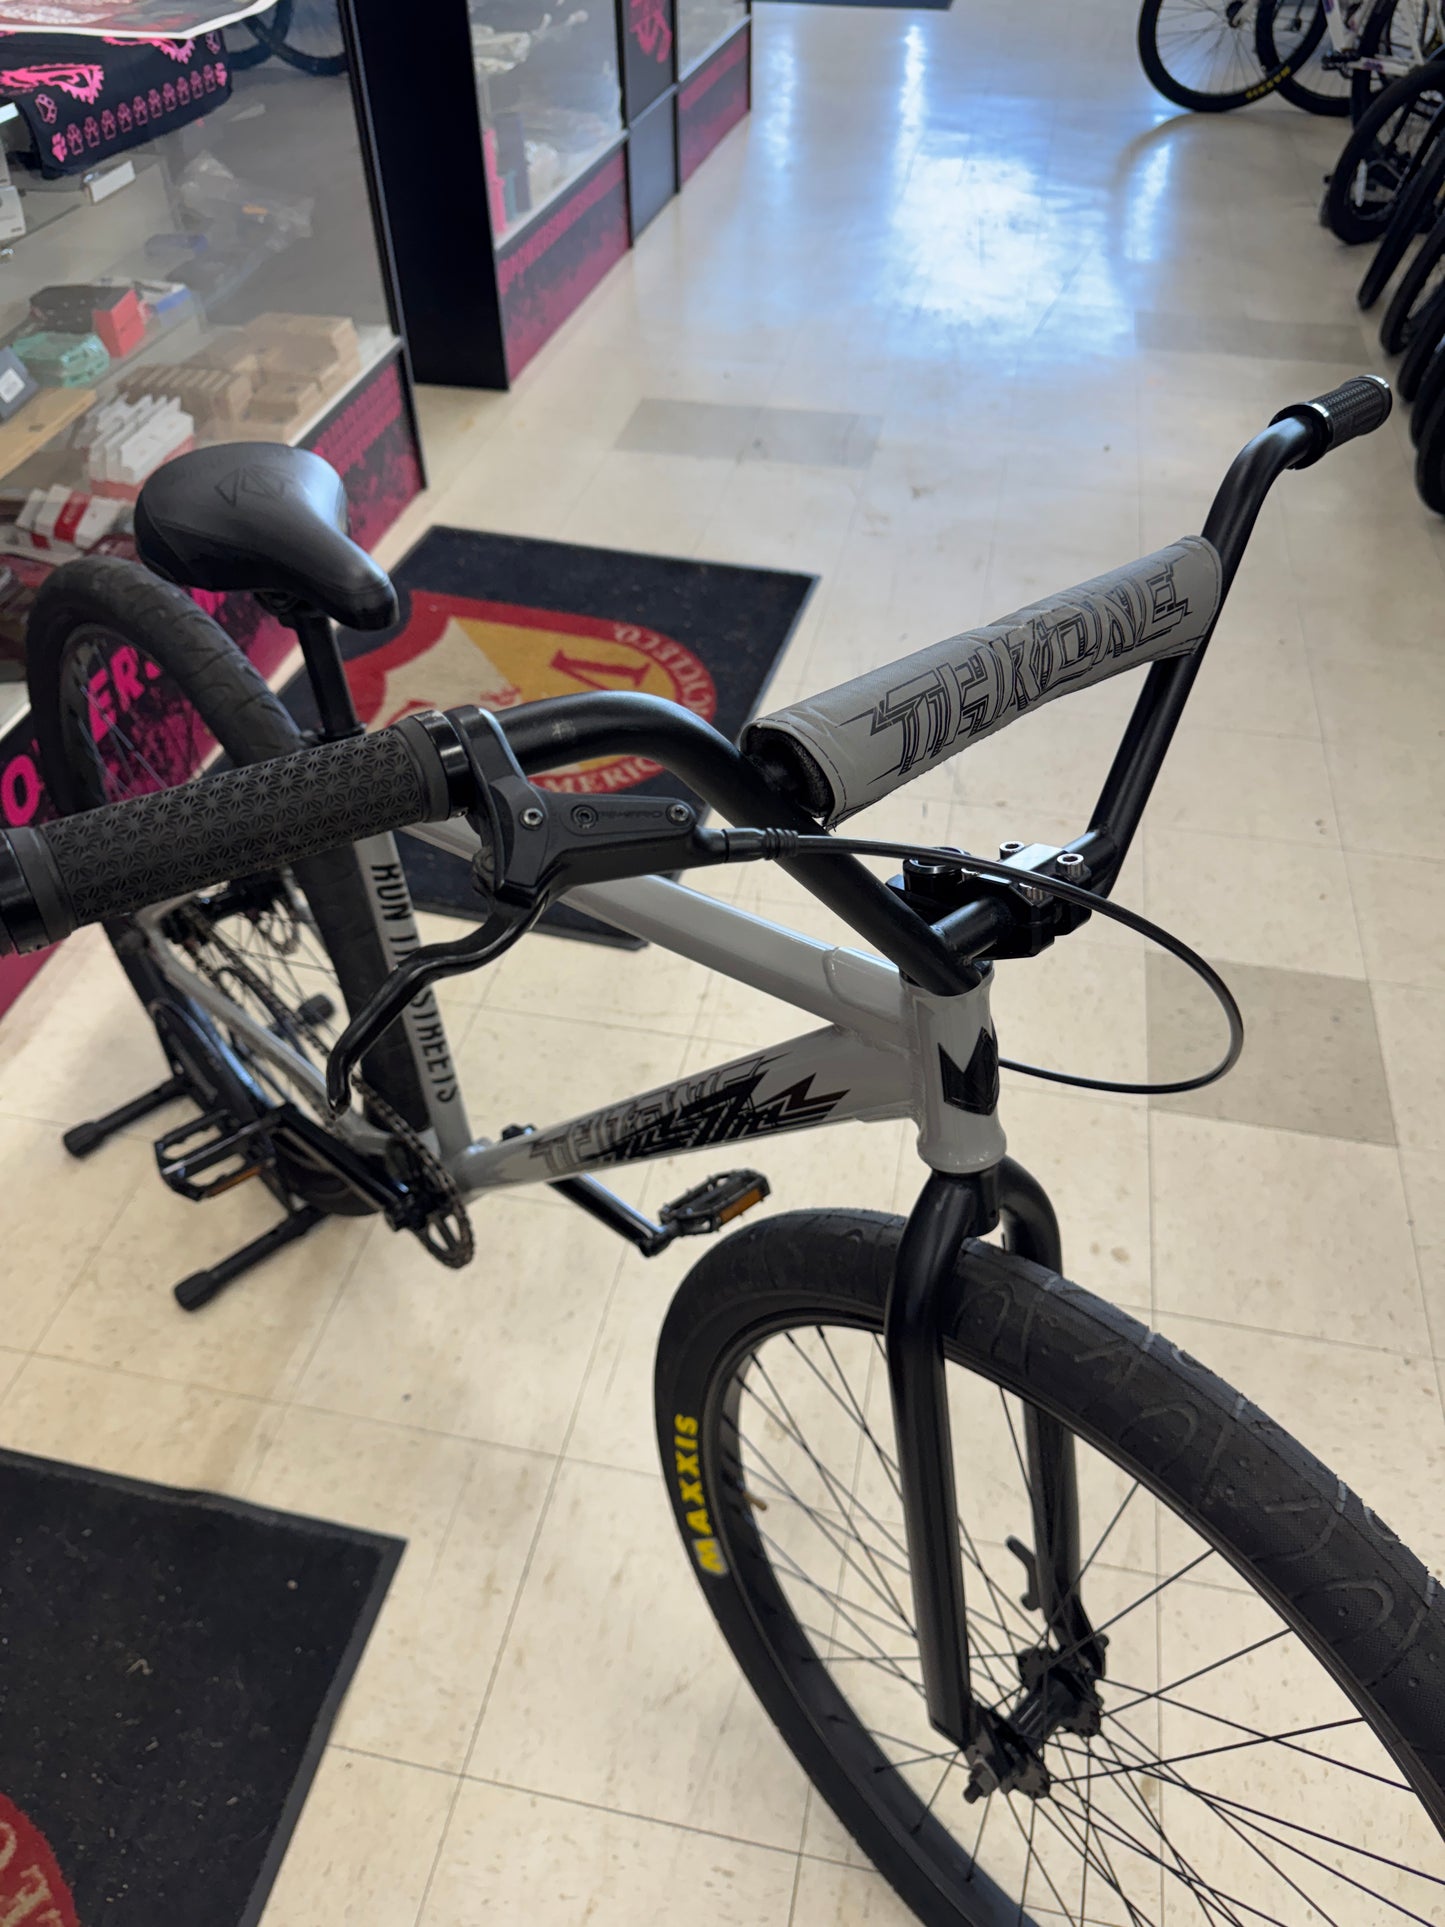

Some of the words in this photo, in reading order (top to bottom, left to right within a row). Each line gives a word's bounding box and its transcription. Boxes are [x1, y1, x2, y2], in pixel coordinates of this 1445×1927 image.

[866, 555, 1192, 778] THRONE
[541, 756, 662, 794] MERIC
[370, 862, 412, 922] RUN
[673, 1412, 726, 1576] MAXXIS
